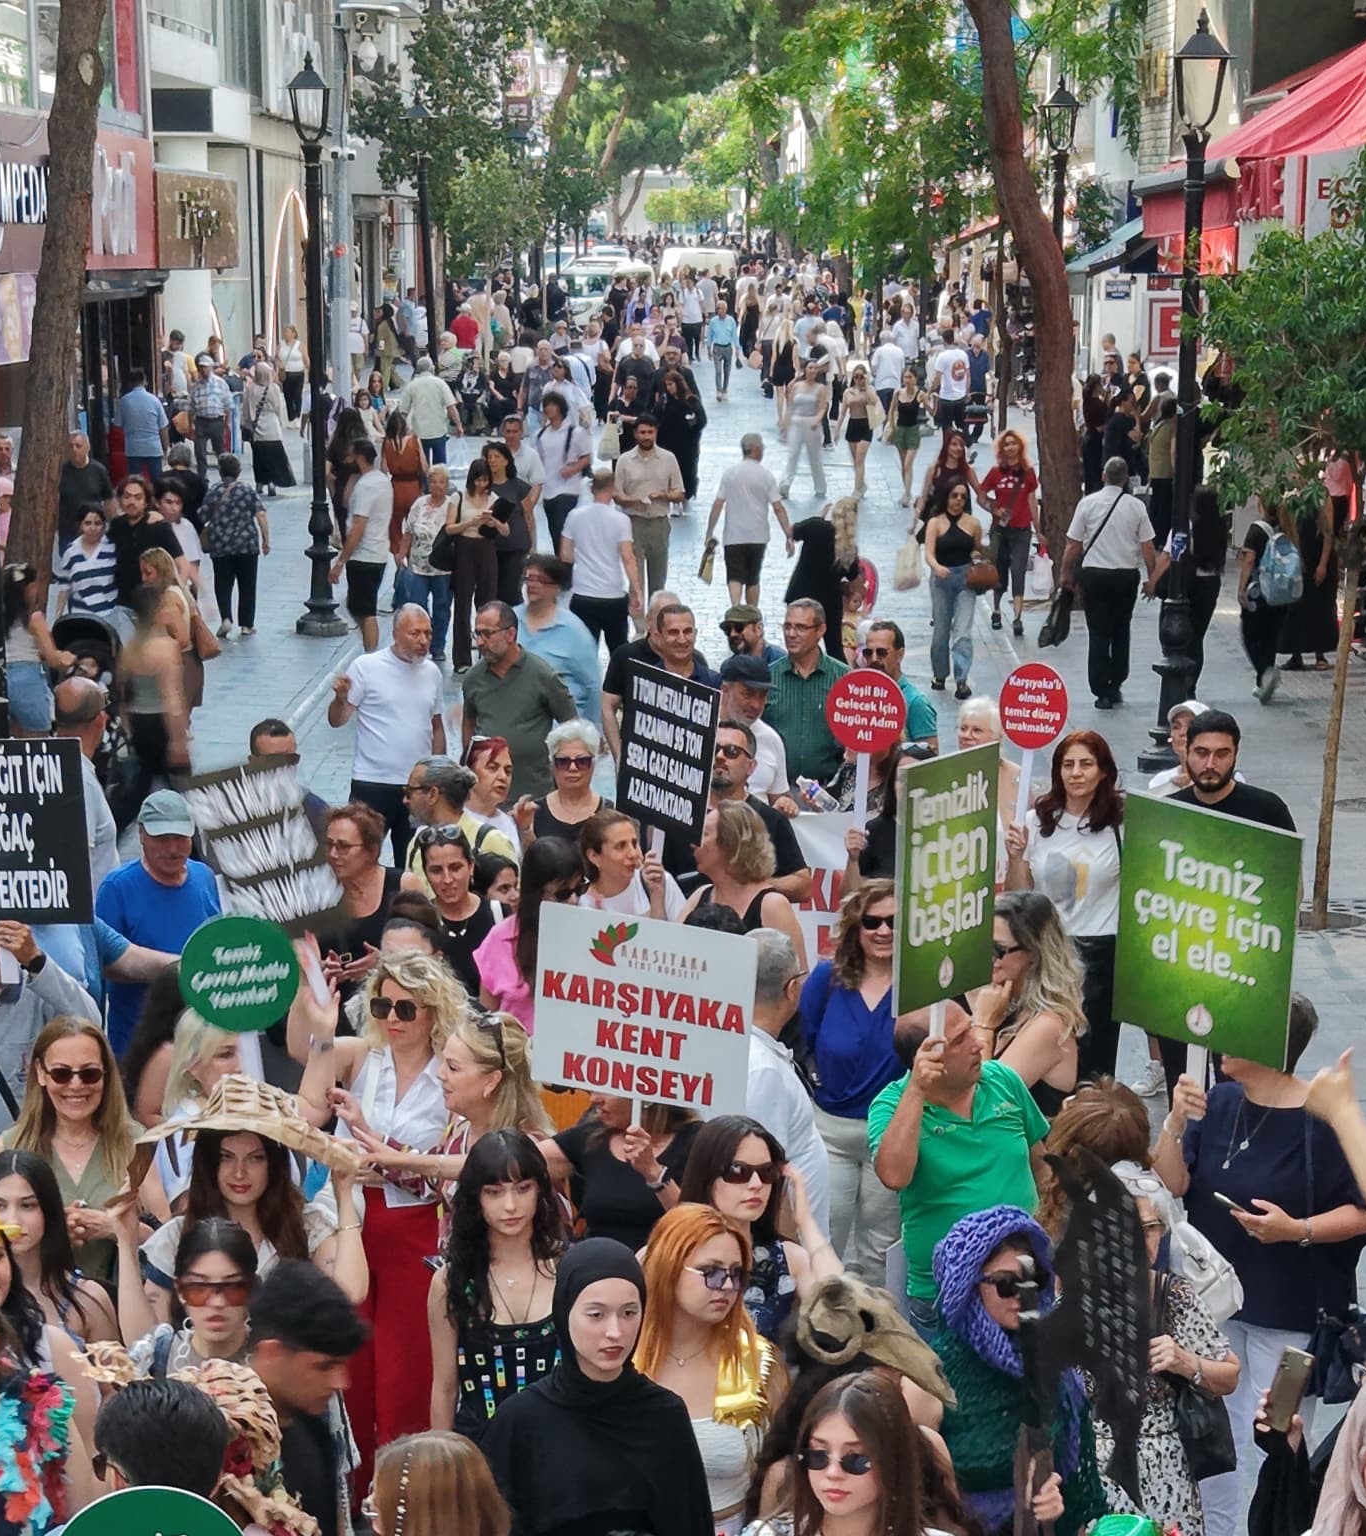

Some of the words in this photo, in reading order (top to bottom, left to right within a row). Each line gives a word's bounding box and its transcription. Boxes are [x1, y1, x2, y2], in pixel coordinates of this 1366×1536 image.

[833, 711, 868, 729] Bugün
[835, 697, 878, 713] Gelecek
[878, 702, 898, 716] İçin
[847, 683, 872, 699] Yeşil
[873, 686, 889, 700] Bir
[1004, 705, 1031, 719] temiz
[1031, 708, 1061, 722] dünya
[1018, 691, 1050, 706] olmak,
[685, 729, 704, 760] TON
[25, 742, 64, 806] İÇİN
[908, 769, 989, 829] Temizlik
[910, 824, 988, 902] içten
[1159, 839, 1265, 905] Temiz
[908, 882, 989, 947] başlar
[1134, 887, 1218, 933] çevre
[1226, 904, 1283, 953] için
[1151, 928, 1178, 964] el
[1186, 939, 1257, 987] ele...
[543, 969, 746, 1035] KARŞIYAKA
[596, 1019, 688, 1061] KENT
[562, 1051, 714, 1106] KONSEYİ
